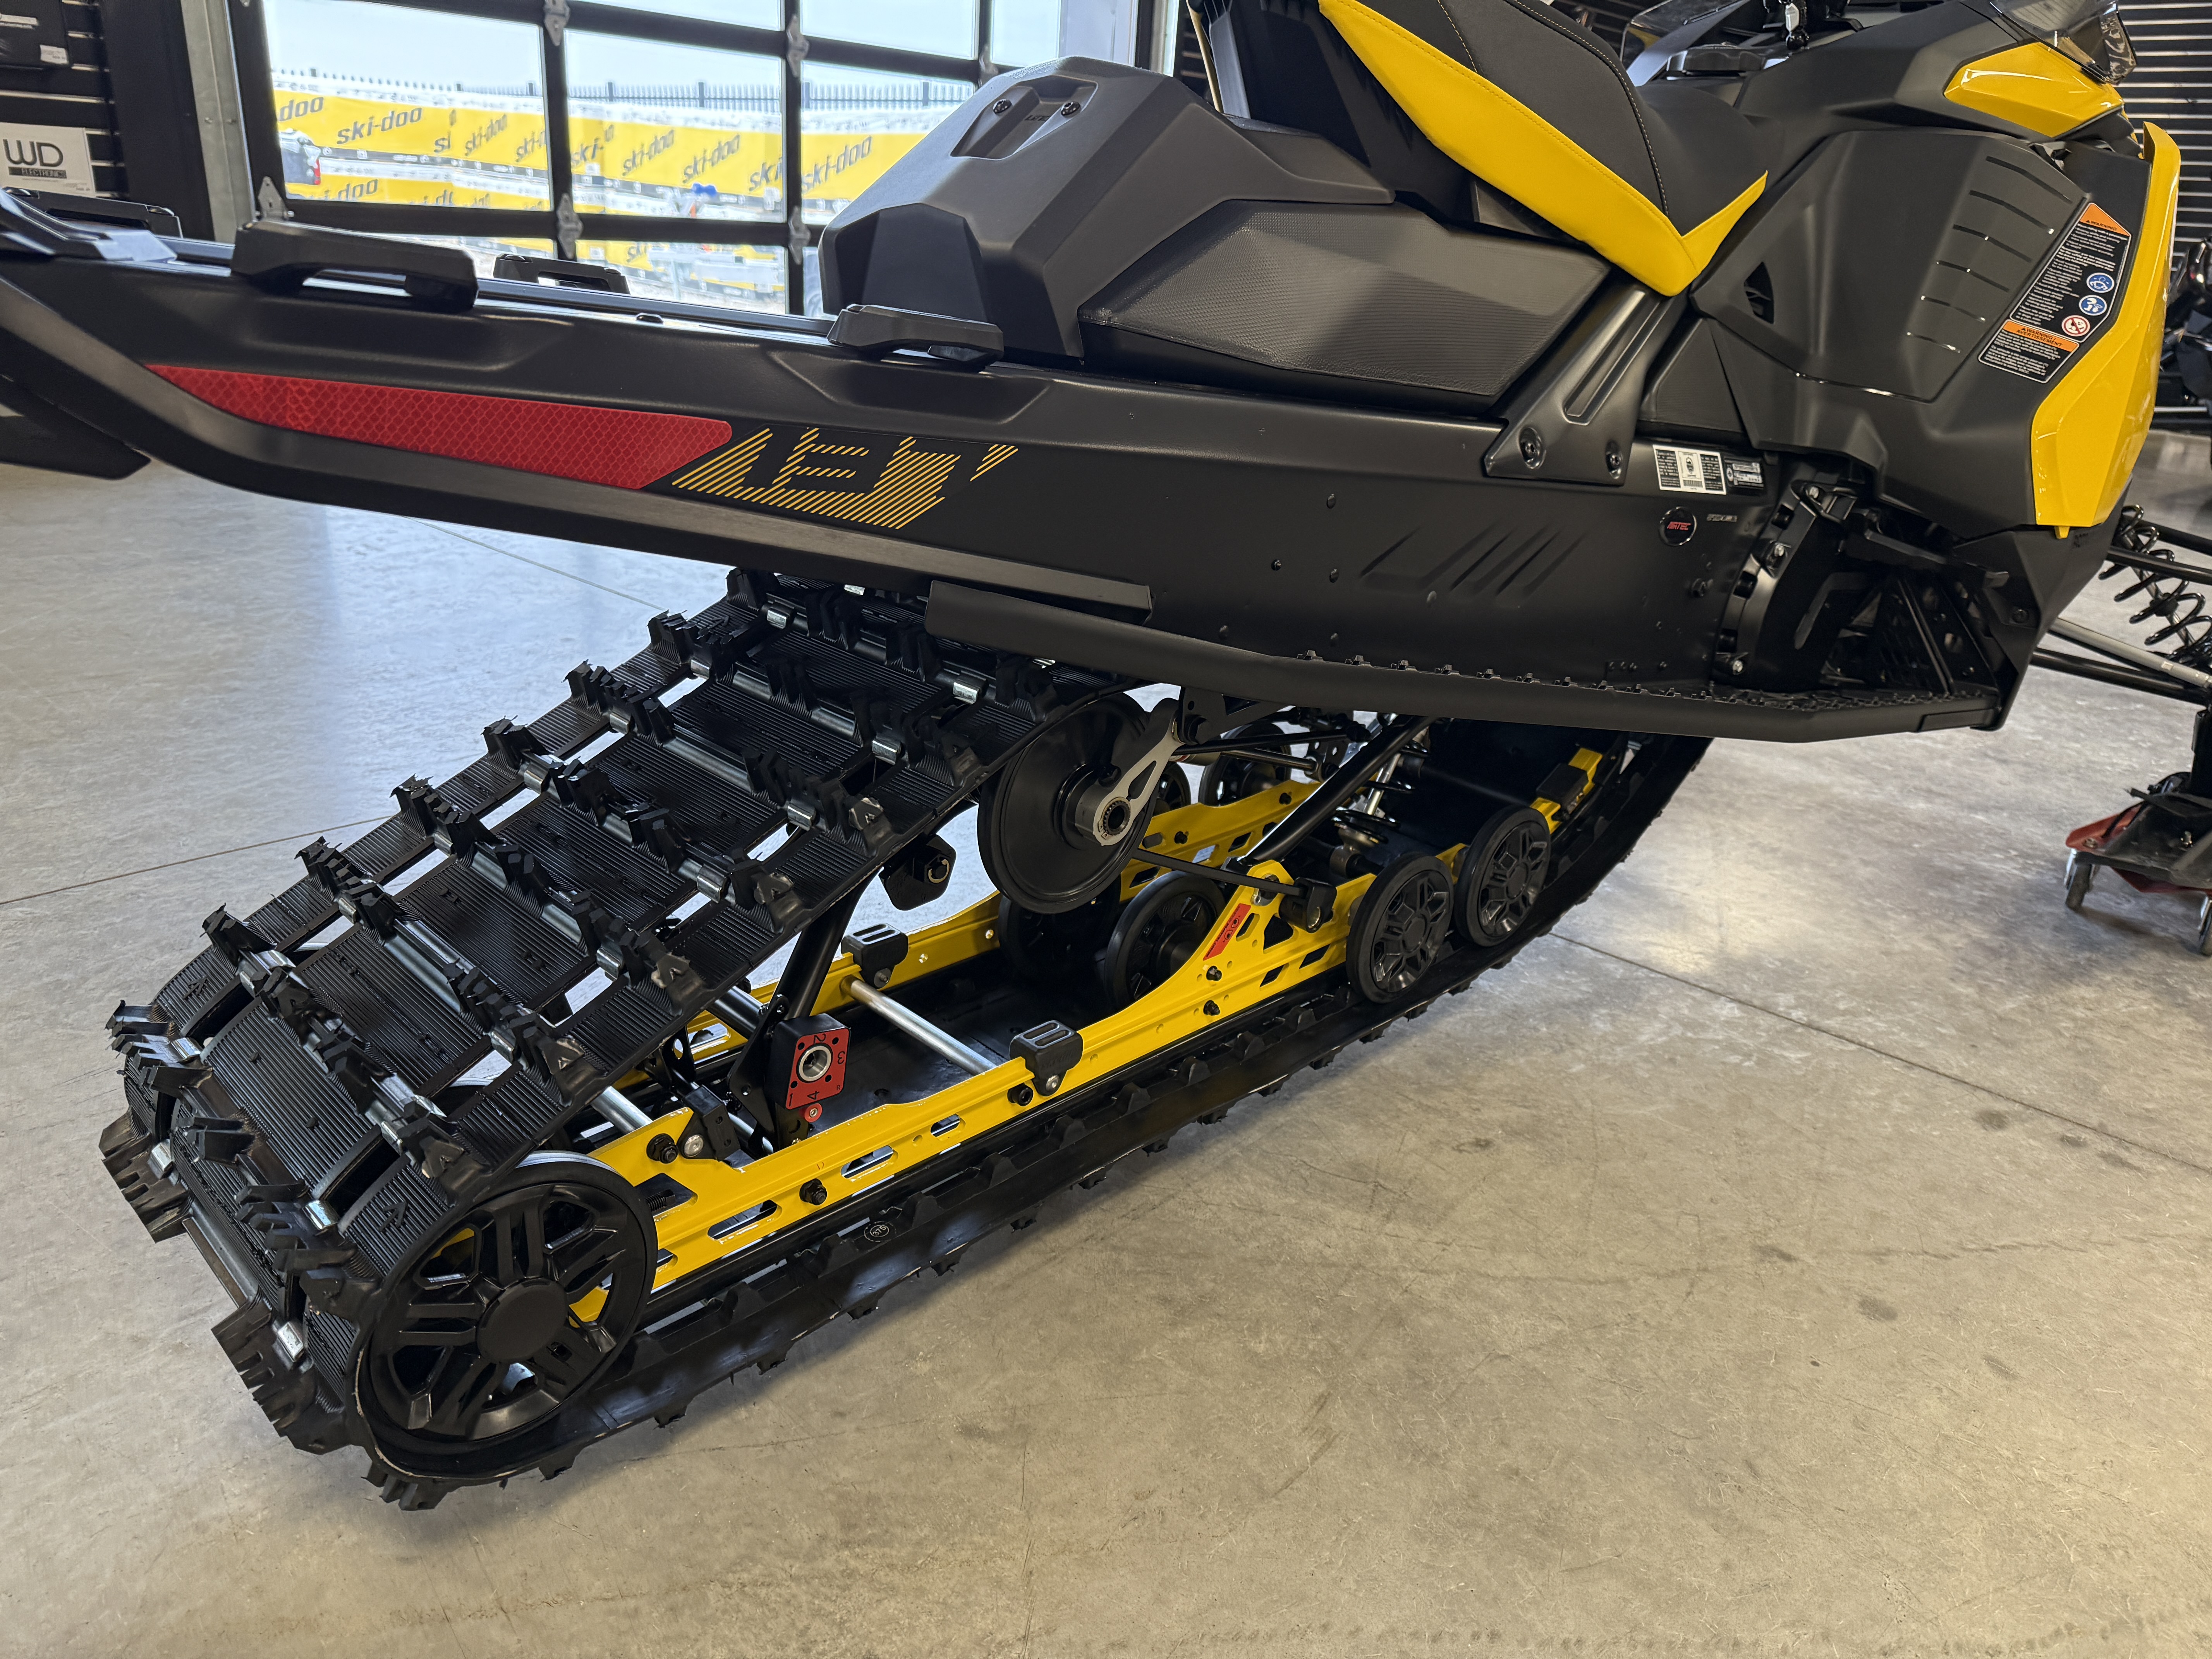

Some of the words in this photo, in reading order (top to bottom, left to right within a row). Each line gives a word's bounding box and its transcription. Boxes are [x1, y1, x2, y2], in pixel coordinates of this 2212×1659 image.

[336, 108, 422, 144] ski-doo
[3, 139, 63, 167] WD
[683, 134, 740, 184] ski-doo
[2016, 330, 2063, 347] AVERTISSEMENT
[2027, 328, 2053, 340] WARNING
[814, 1033, 826, 1044] 2
[837, 1051, 845, 1065] 3
[789, 1093, 793, 1107] 1
[807, 1091, 819, 1100] 4
[872, 1224, 886, 1236] 375
